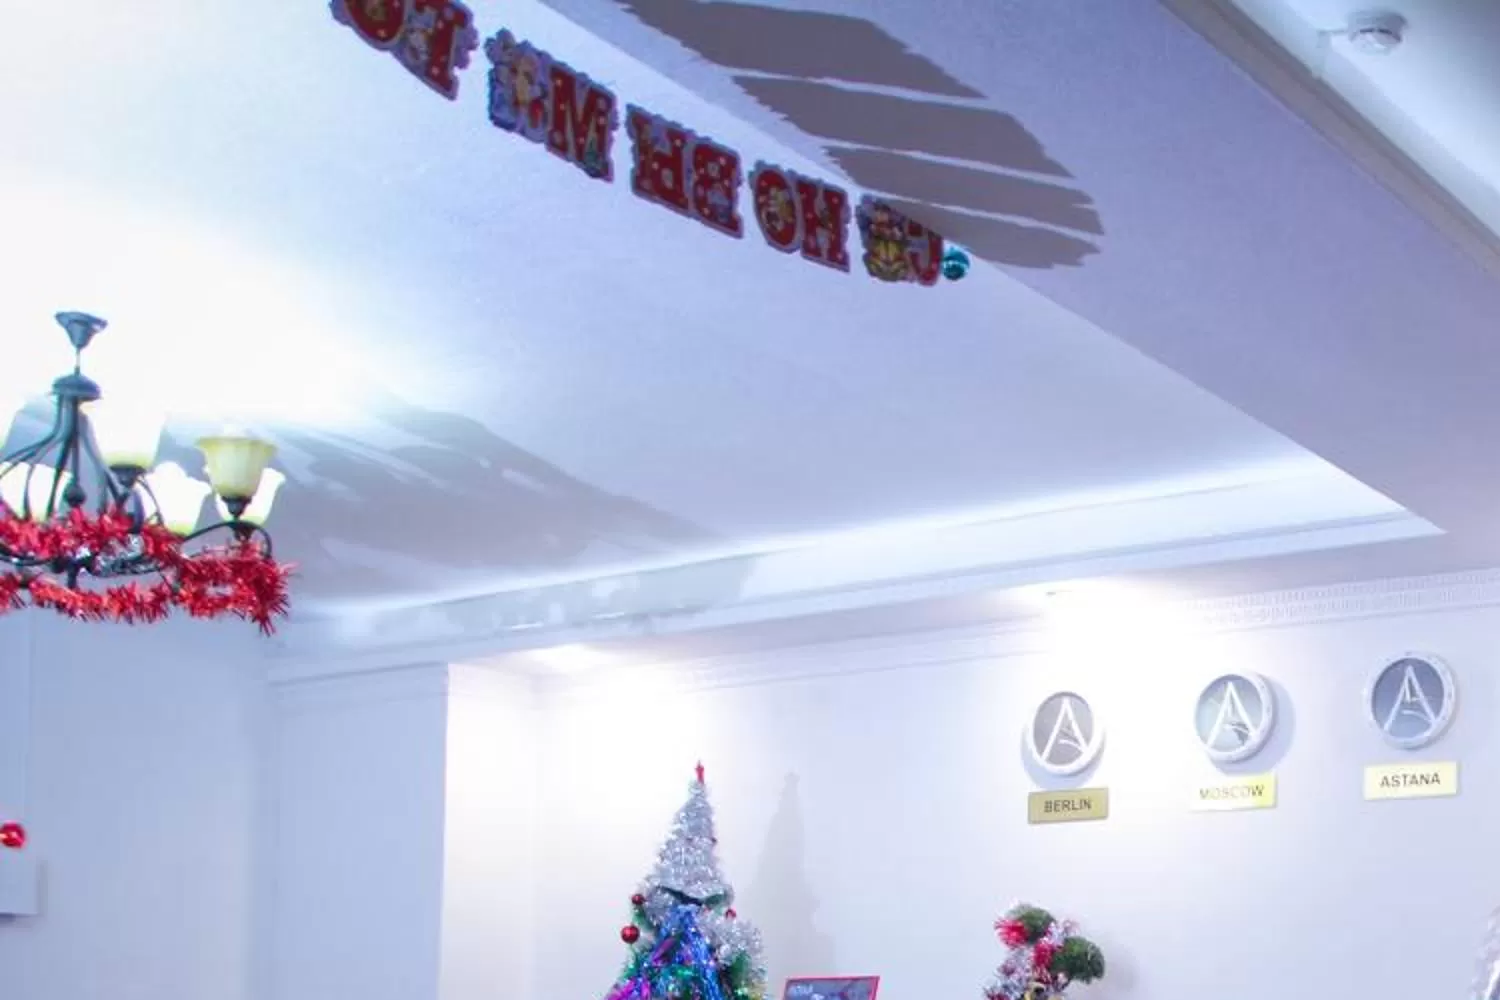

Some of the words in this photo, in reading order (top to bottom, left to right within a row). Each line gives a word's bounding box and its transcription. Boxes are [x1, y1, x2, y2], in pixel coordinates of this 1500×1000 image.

[1379, 771, 1441, 788] ASTANA
[1198, 784, 1266, 800] MOSCOW
[1043, 799, 1093, 814] BERLIN
